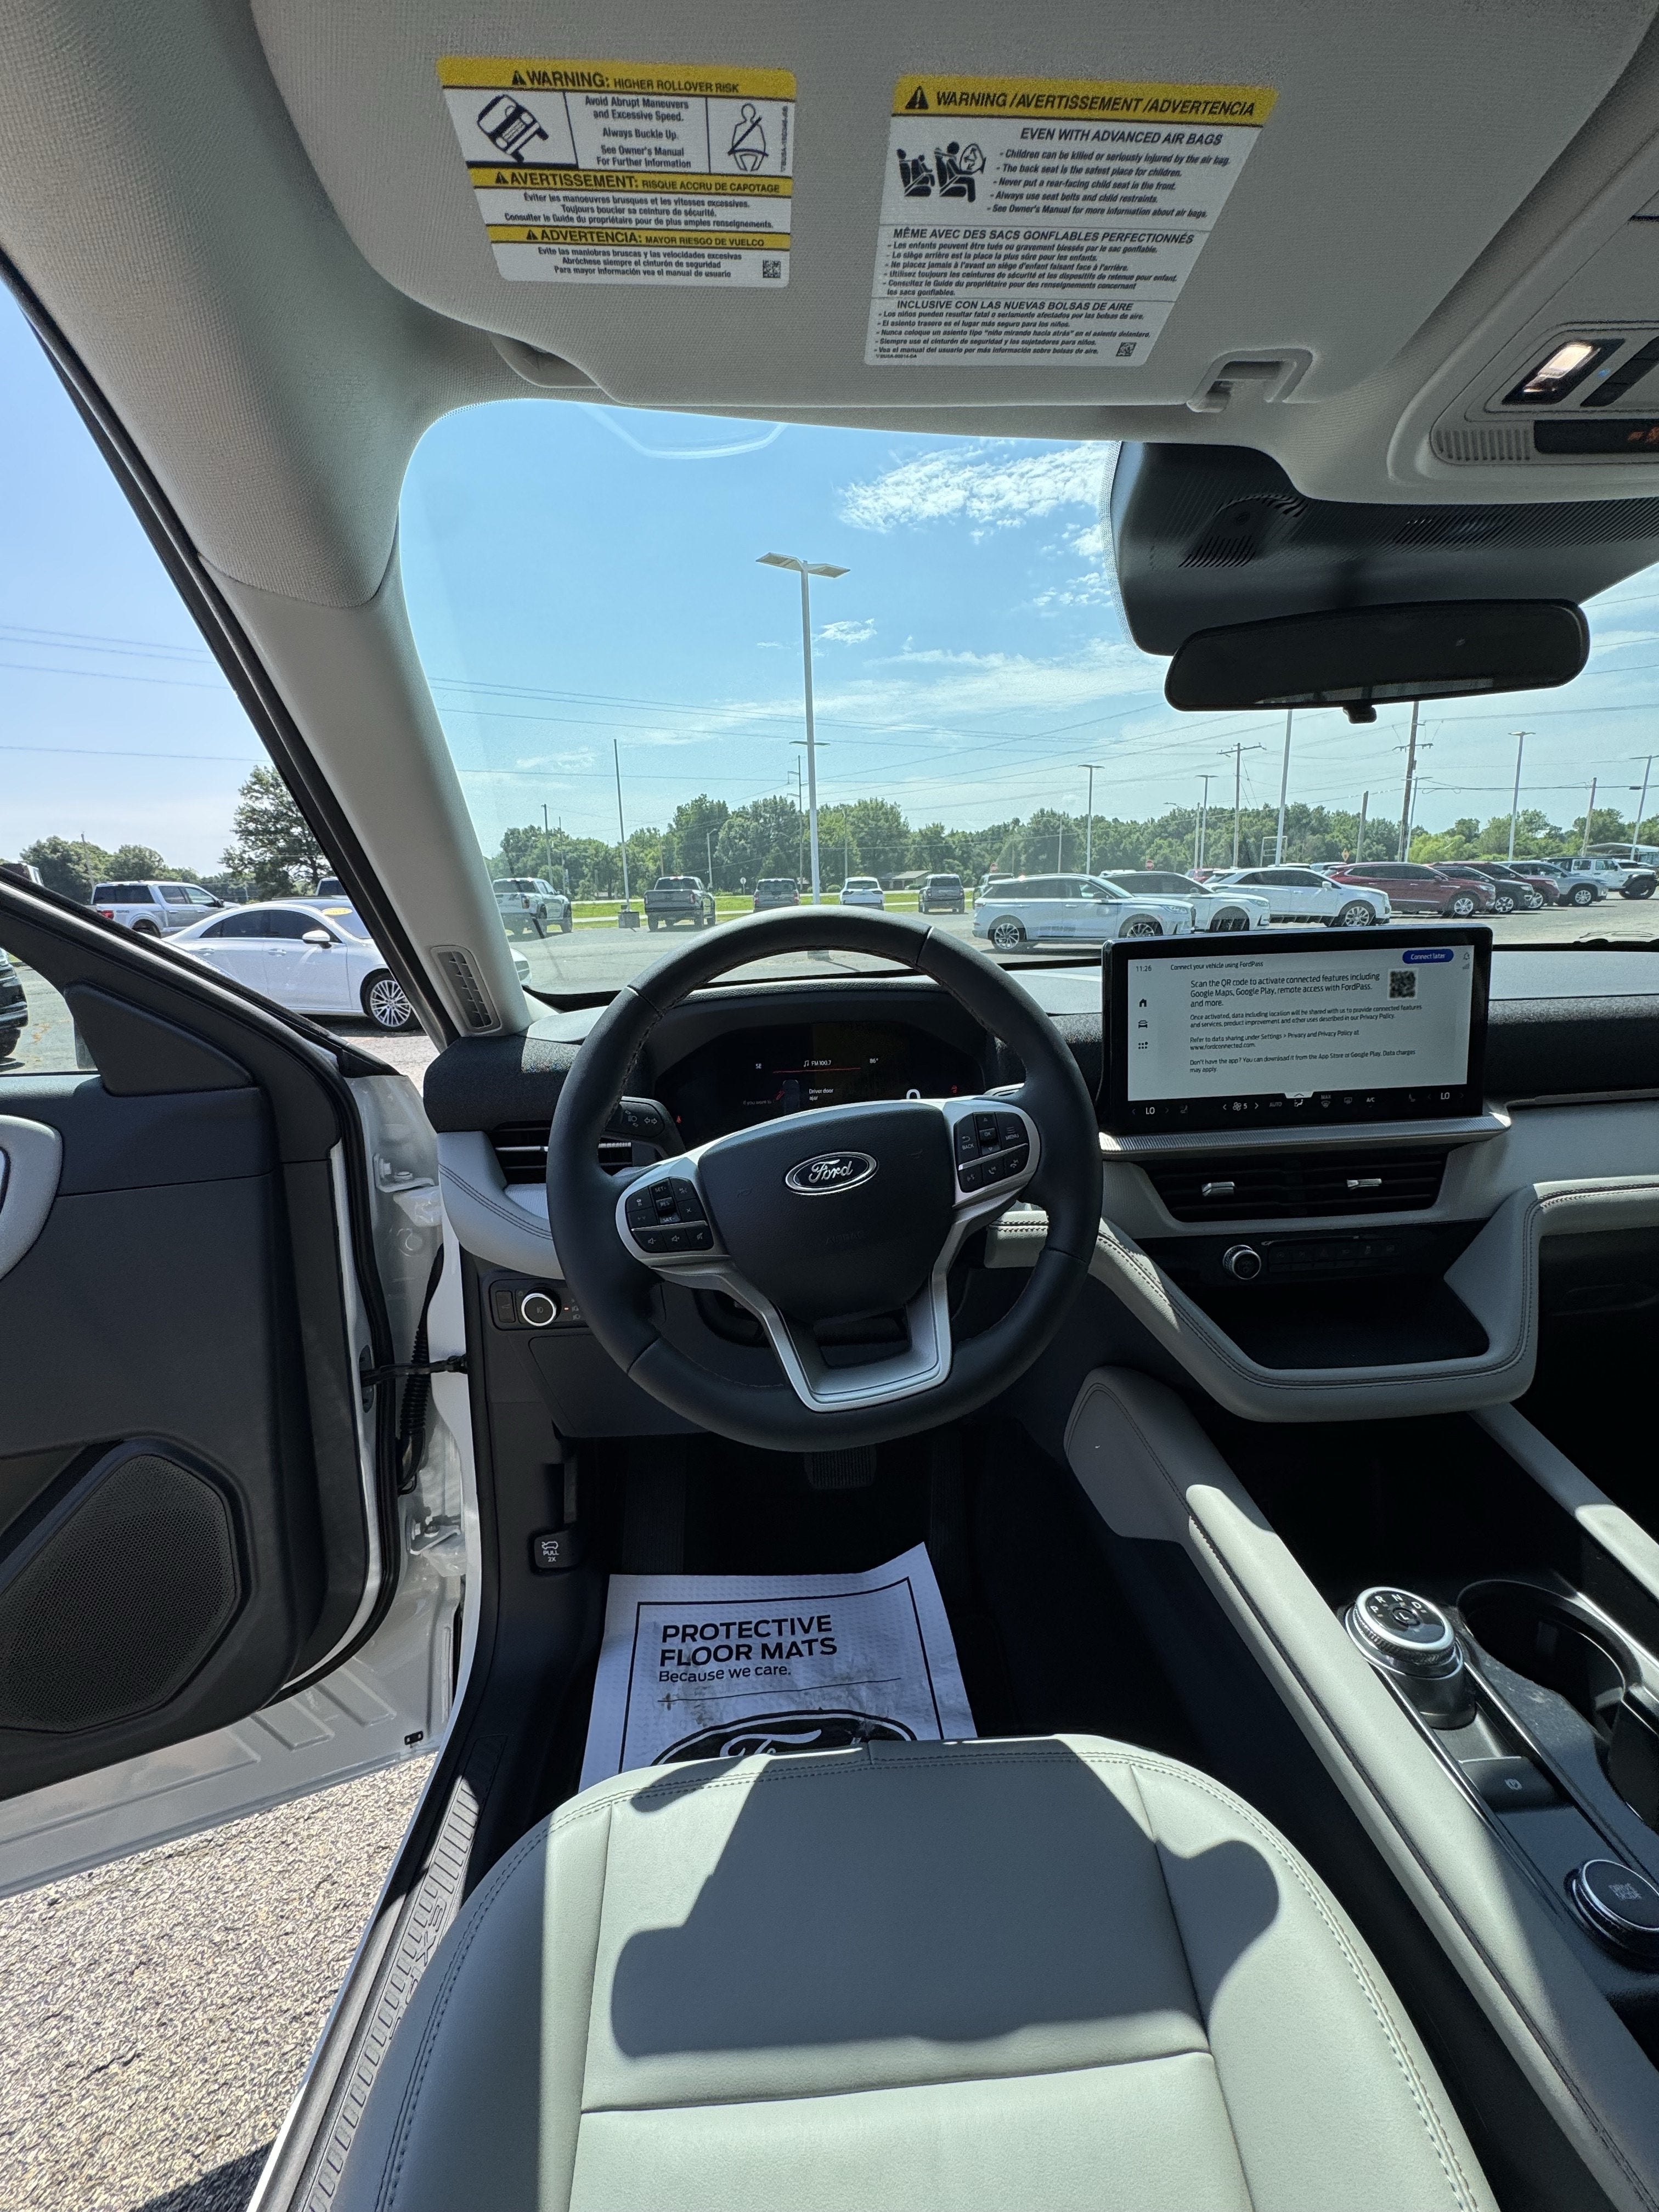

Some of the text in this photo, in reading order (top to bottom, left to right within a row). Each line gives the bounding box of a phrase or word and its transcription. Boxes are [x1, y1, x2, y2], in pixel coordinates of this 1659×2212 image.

[526, 71, 739, 92] WARNING: HIGHER ROLLOVER RISK
[585, 95, 689, 109] Avoid Abrupt Maneuvers
[936, 90, 1255, 116] WARNING /AVERTISSEMENT /ADVERTENCIA
[592, 110, 684, 123] and Excessive Speed.
[602, 128, 678, 140] Always Buckle Up.
[1020, 127, 1223, 145] EVEN WITH ADVANCED AIR BAGS
[600, 145, 684, 156] See Owner's Manual
[1003, 149, 1040, 159] Children
[1058, 150, 1069, 160] be
[1070, 151, 1094, 160] killed
[1105, 152, 1143, 163] seriously
[1143, 153, 1173, 164] injured
[1173, 154, 1184, 165] by
[1185, 155, 1200, 163] the
[1199, 155, 1212, 163] air
[1212, 156, 1229, 166] bag.
[596, 156, 691, 168] For Further Information
[1002, 163, 1182, 177] The back seat is the safest place for children.
[510, 172, 780, 193] AVERTISSEMENT: RISQUE ACCRU DE CAPOTAGE
[996, 177, 1022, 185] Never
[1022, 178, 1038, 188] put
[1046, 178, 1090, 189] rear-facing
[1091, 180, 1111, 188] child
[1111, 180, 1130, 189] seat
[1140, 181, 1154, 189] the
[1155, 182, 1176, 190] front.
[1008, 204, 1040, 213] Owner's
[1041, 205, 1071, 213] Manual
[1106, 207, 1151, 216] information
[1151, 208, 1175, 216] about
[1174, 208, 1186, 217] air
[1187, 209, 1207, 218] bags.
[540, 229, 642, 243] ADVERTENCIA:
[728, 238, 764, 246] VUELCO
[893, 228, 1194, 243] MÊME AVEC DES SACS GONFLABLES PERFECTIONNÉS
[897, 300, 952, 309] INCLUSIVE
[980, 301, 1001, 309] LAS
[1003, 301, 1046, 309] NUEVAS
[1047, 302, 1091, 310] BOLSAS
[1285, 975, 1321, 983] connected
[1322, 973, 1349, 981] features
[1350, 973, 1380, 981] including
[1190, 989, 1214, 998] Google
[1215, 989, 1234, 997] Maps,
[1235, 987, 1259, 996] Google
[1260, 986, 1276, 995] Play,
[1440, 1092, 1450, 1101] LO
[1146, 1107, 1155, 1115] LO
[808, 1159, 854, 1183] Ford
[1374, 1595, 1386, 1604] R
[662, 1615, 832, 1643] PROTECTIVE
[660, 1637, 837, 1667] FLOOR MATS
[659, 1666, 791, 1683] Because we care.
